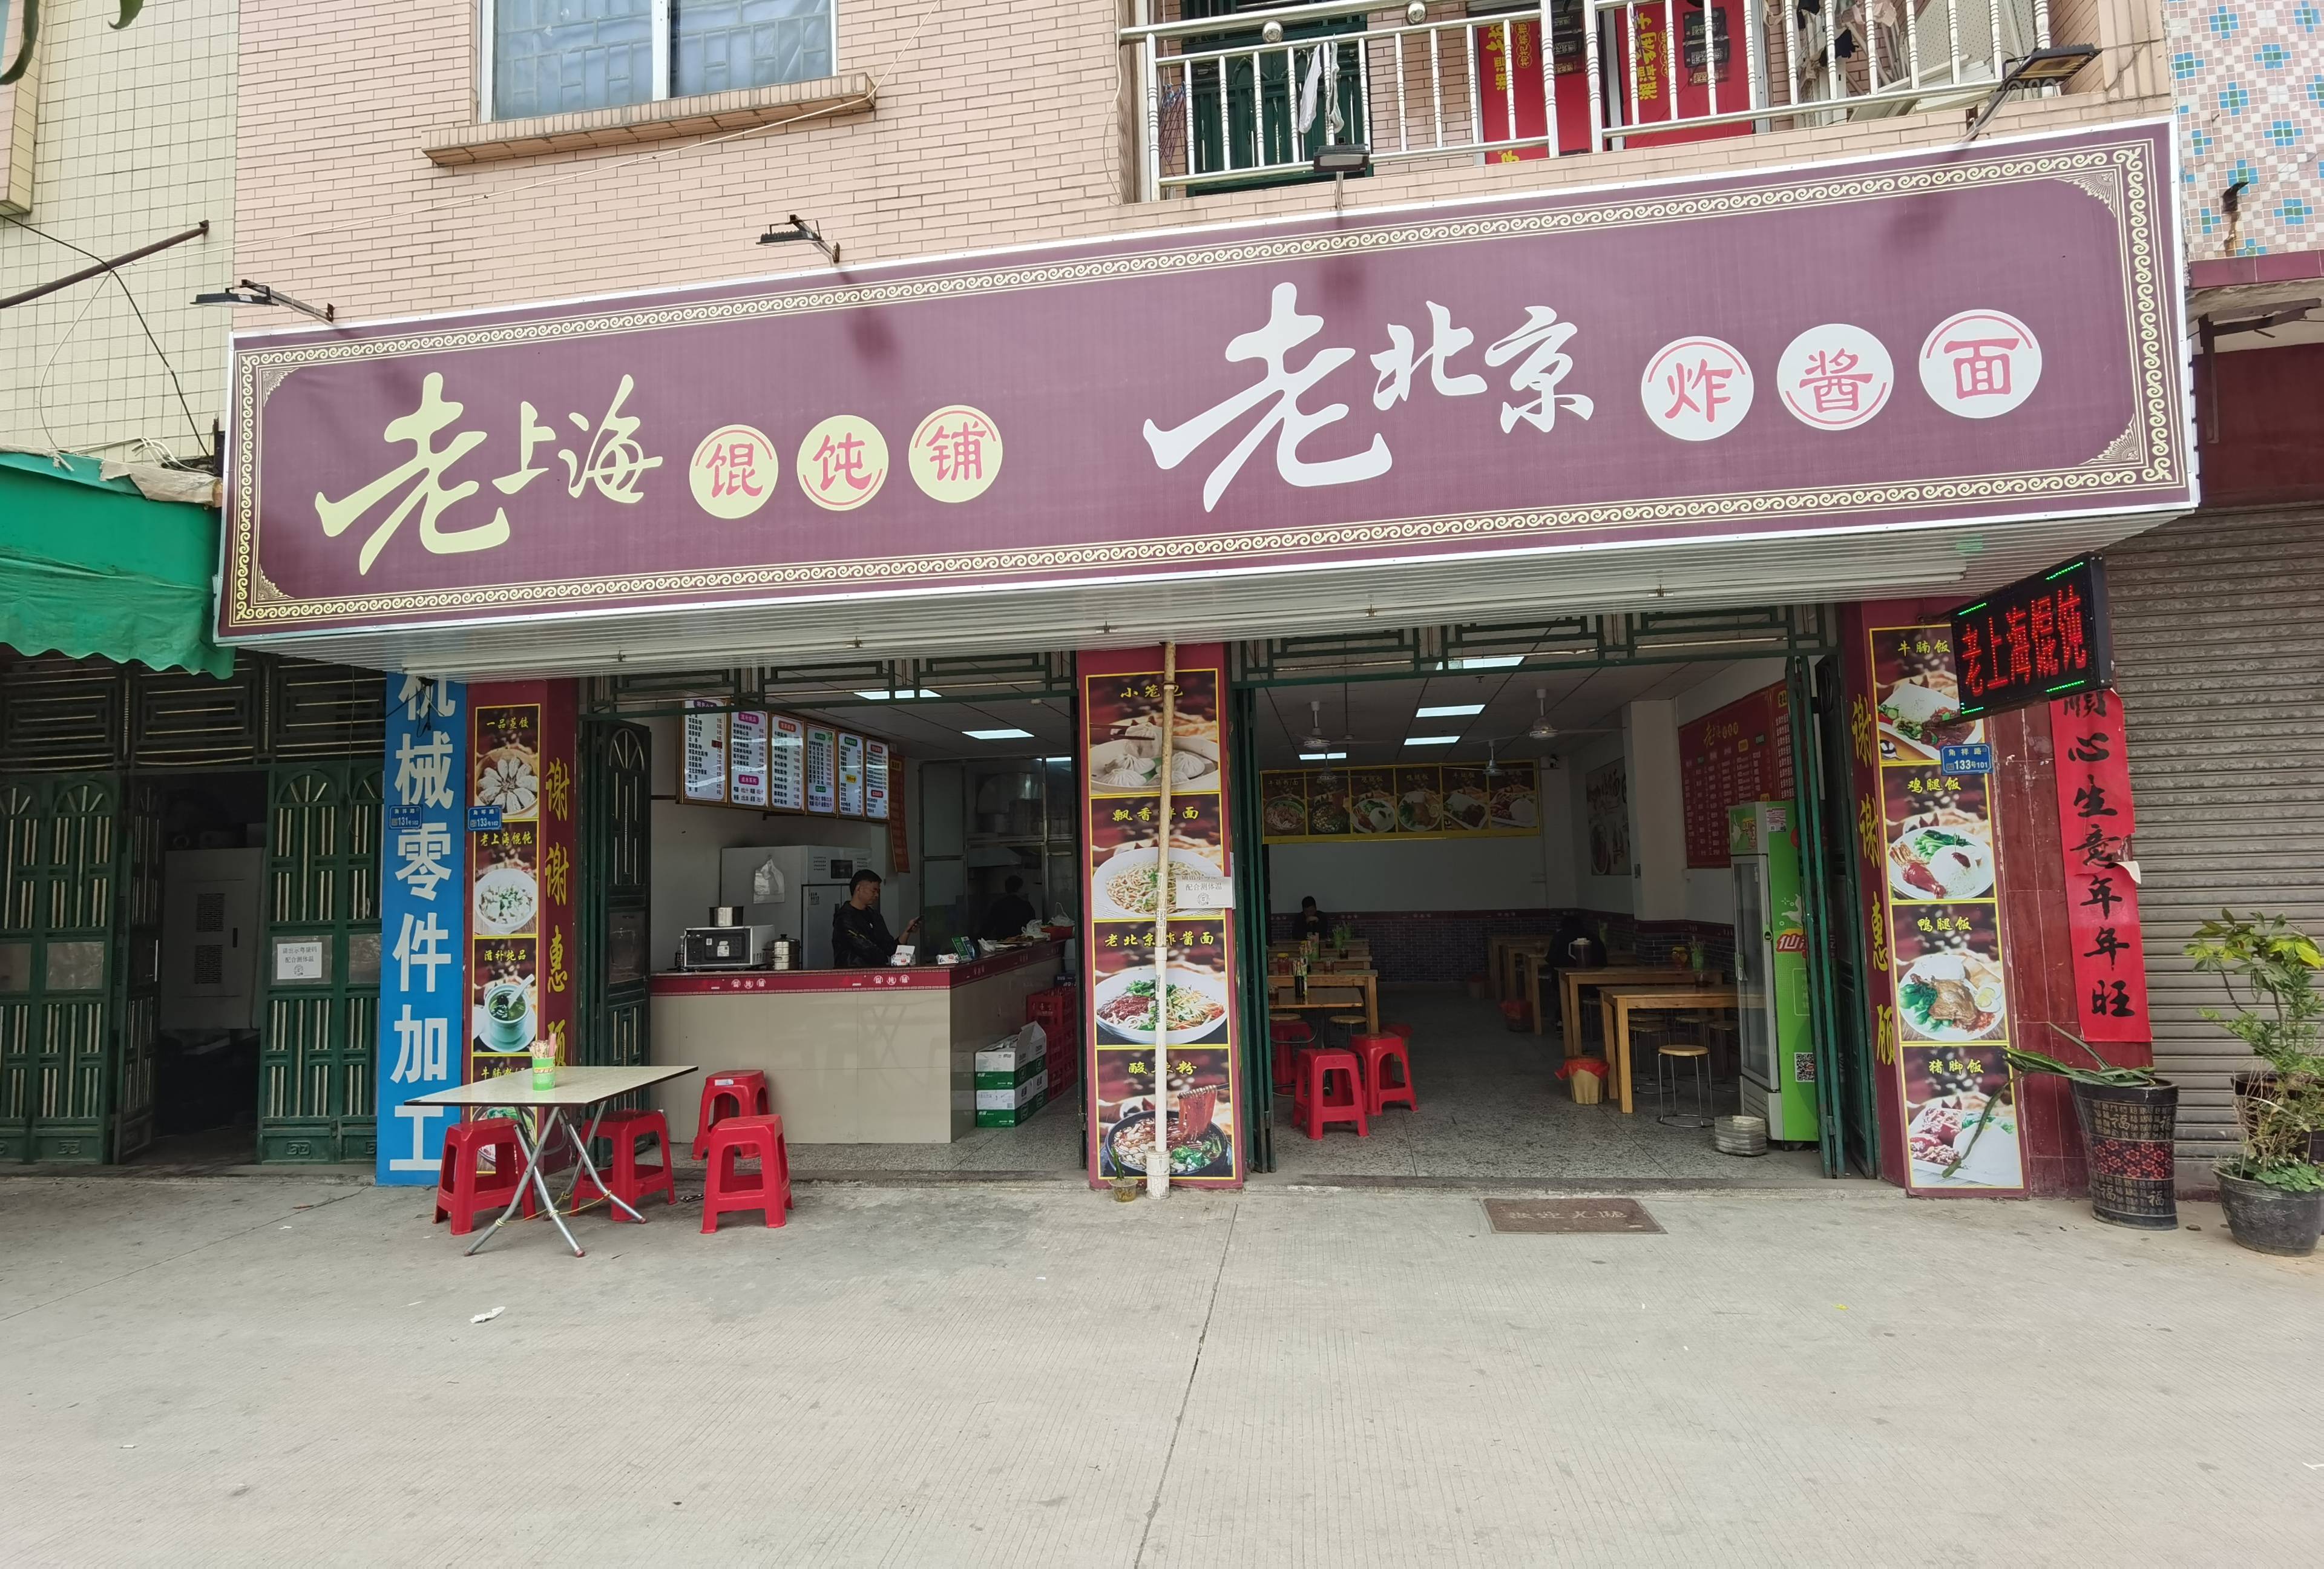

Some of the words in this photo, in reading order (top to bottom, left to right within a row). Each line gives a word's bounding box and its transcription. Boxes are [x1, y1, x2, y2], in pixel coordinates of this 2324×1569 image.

[1143, 282, 2021, 513] 老北京炸酱面
[315, 372, 983, 575] 老上海馄饨铺
[1898, 640, 1951, 657] 牛腩饭
[1961, 585, 2087, 697] 老上海馄饨
[487, 717, 529, 729] 一品蒸饺
[1908, 777, 1961, 793] 鸡腿饭
[480, 831, 533, 846] 老上海馄饨
[389, 674, 456, 1172] 机械零件加工
[1917, 916, 1972, 932] 鸭腿饭
[484, 949, 527, 961] 滋补炖品
[1929, 1059, 1984, 1074] 猪脚饭
